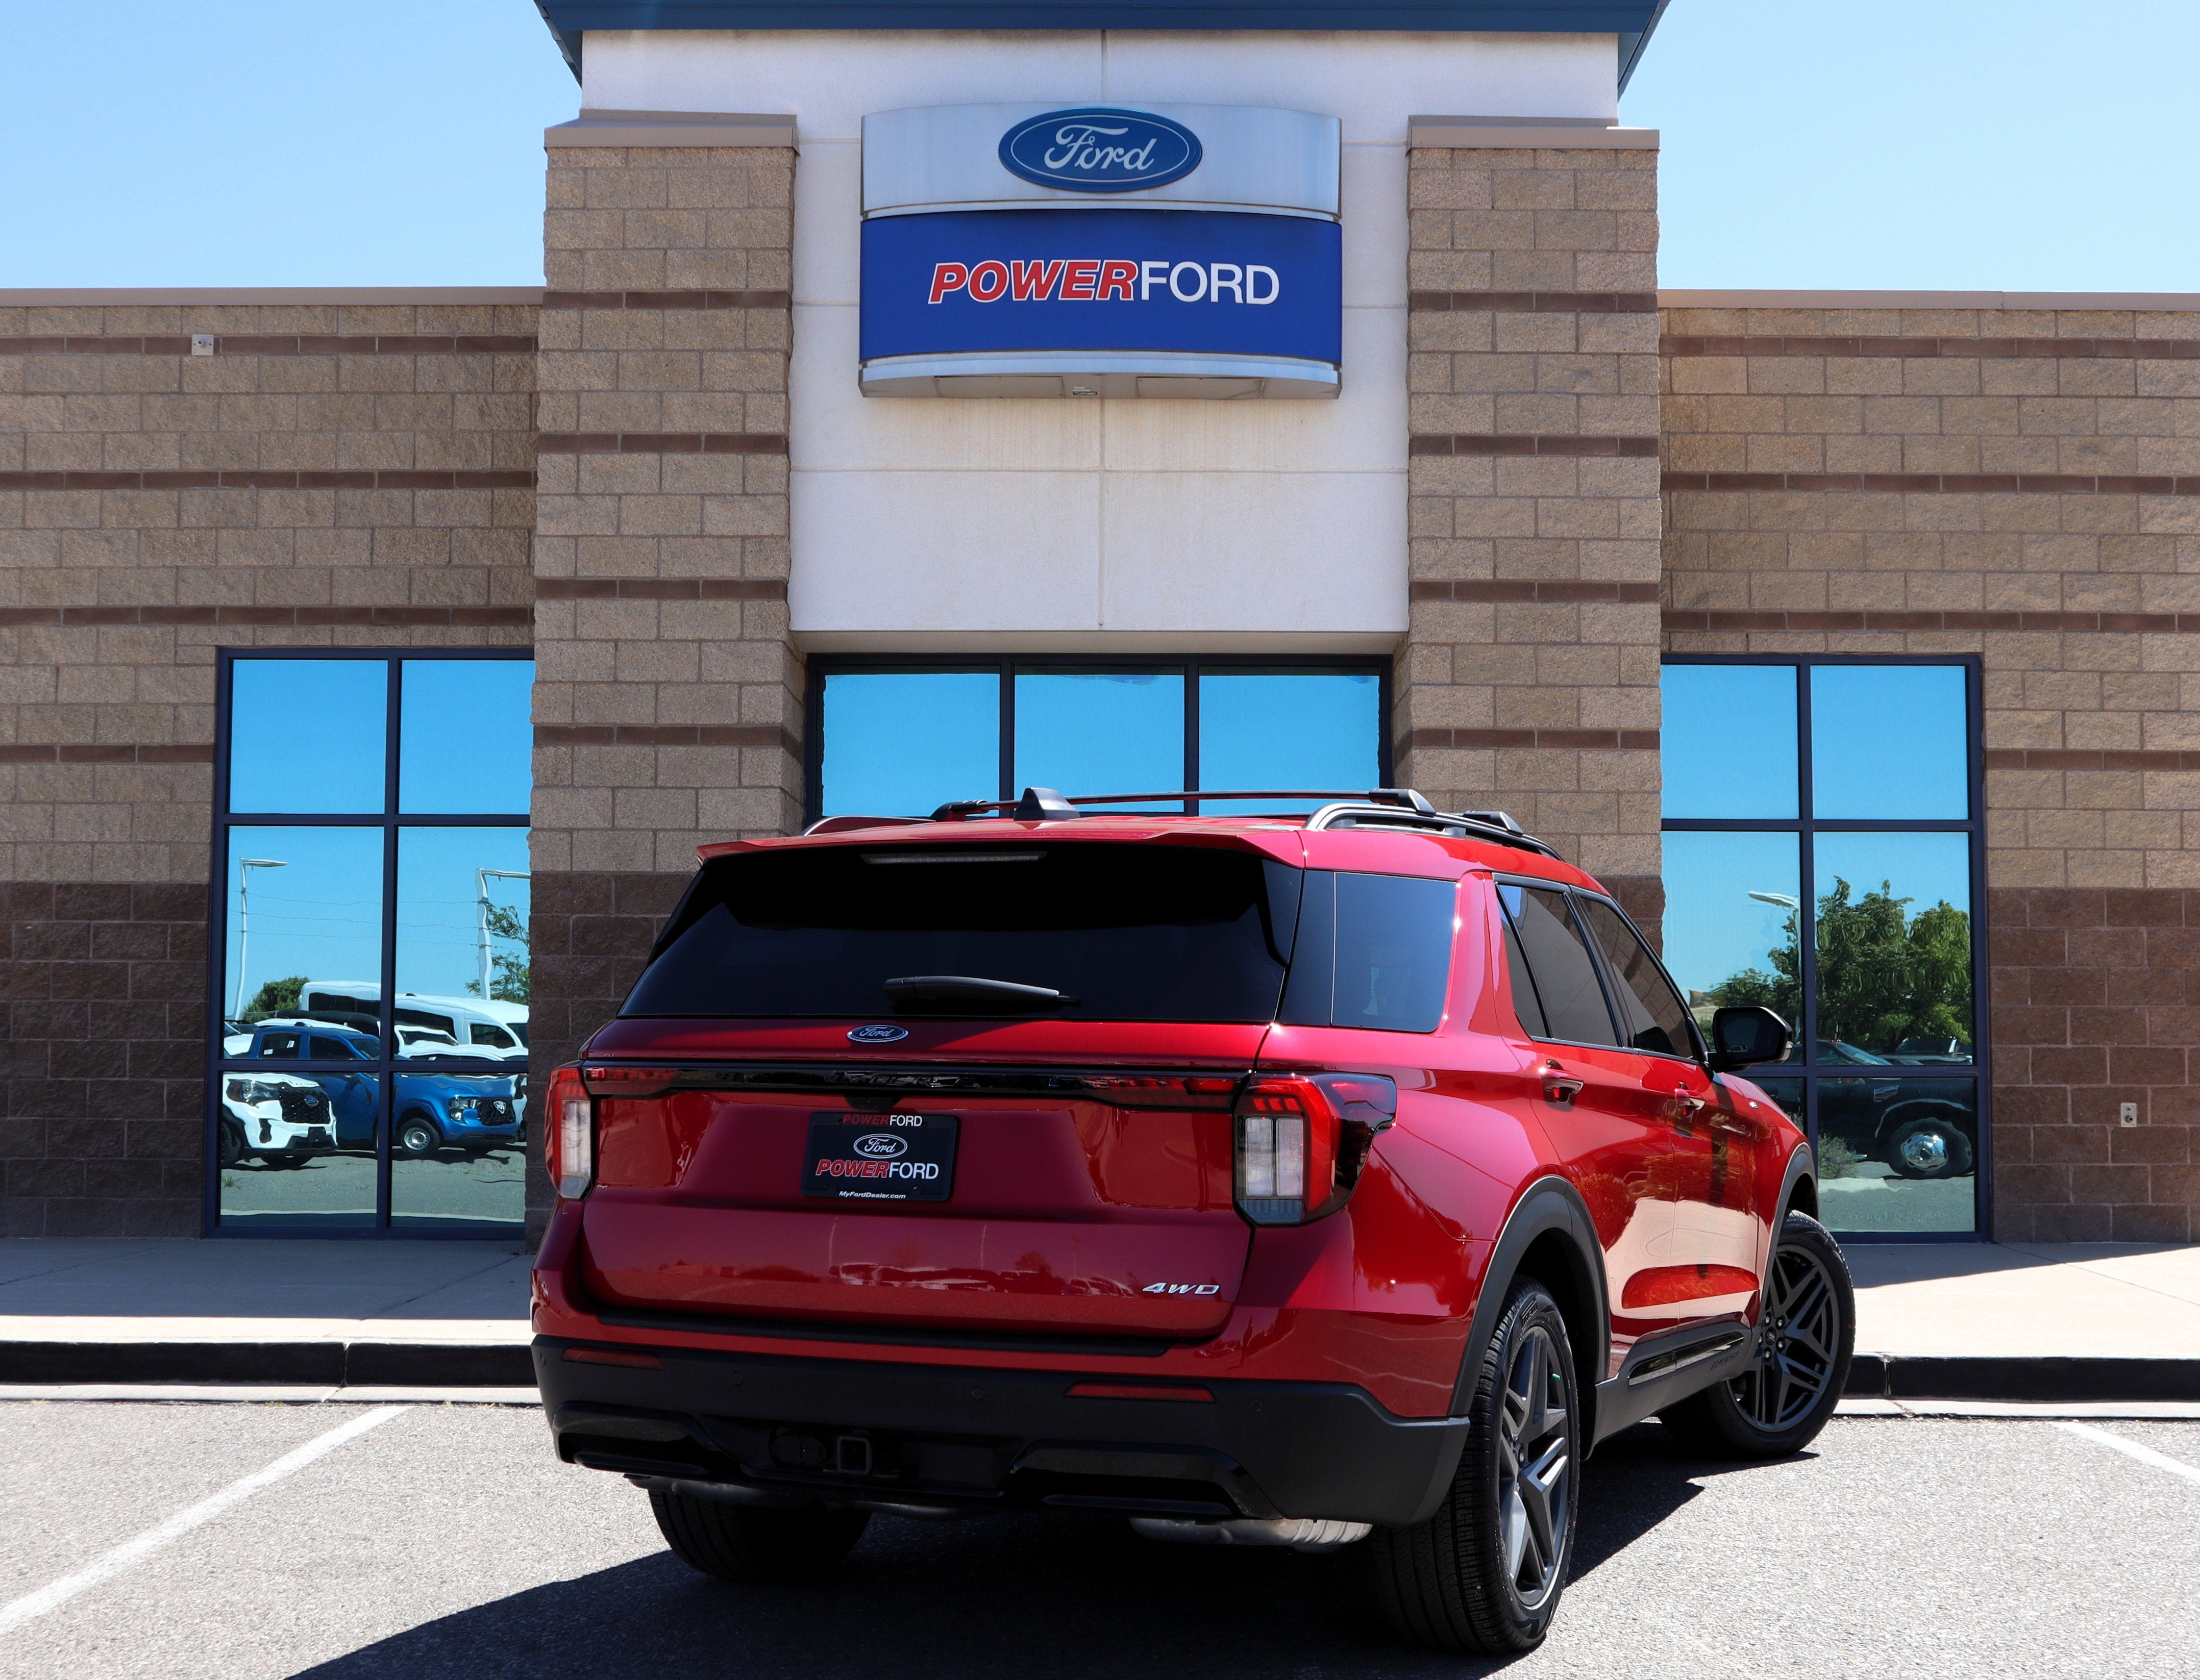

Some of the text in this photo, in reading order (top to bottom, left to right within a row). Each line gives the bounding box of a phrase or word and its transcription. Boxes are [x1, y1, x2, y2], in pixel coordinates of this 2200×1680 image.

[1044, 124, 1158, 170] Ford
[859, 1026, 895, 1037] Ford
[864, 1138, 897, 1153] Ford
[838, 1191, 906, 1199] MyFordDealer.com
[1142, 1282, 1220, 1294] 4WD
